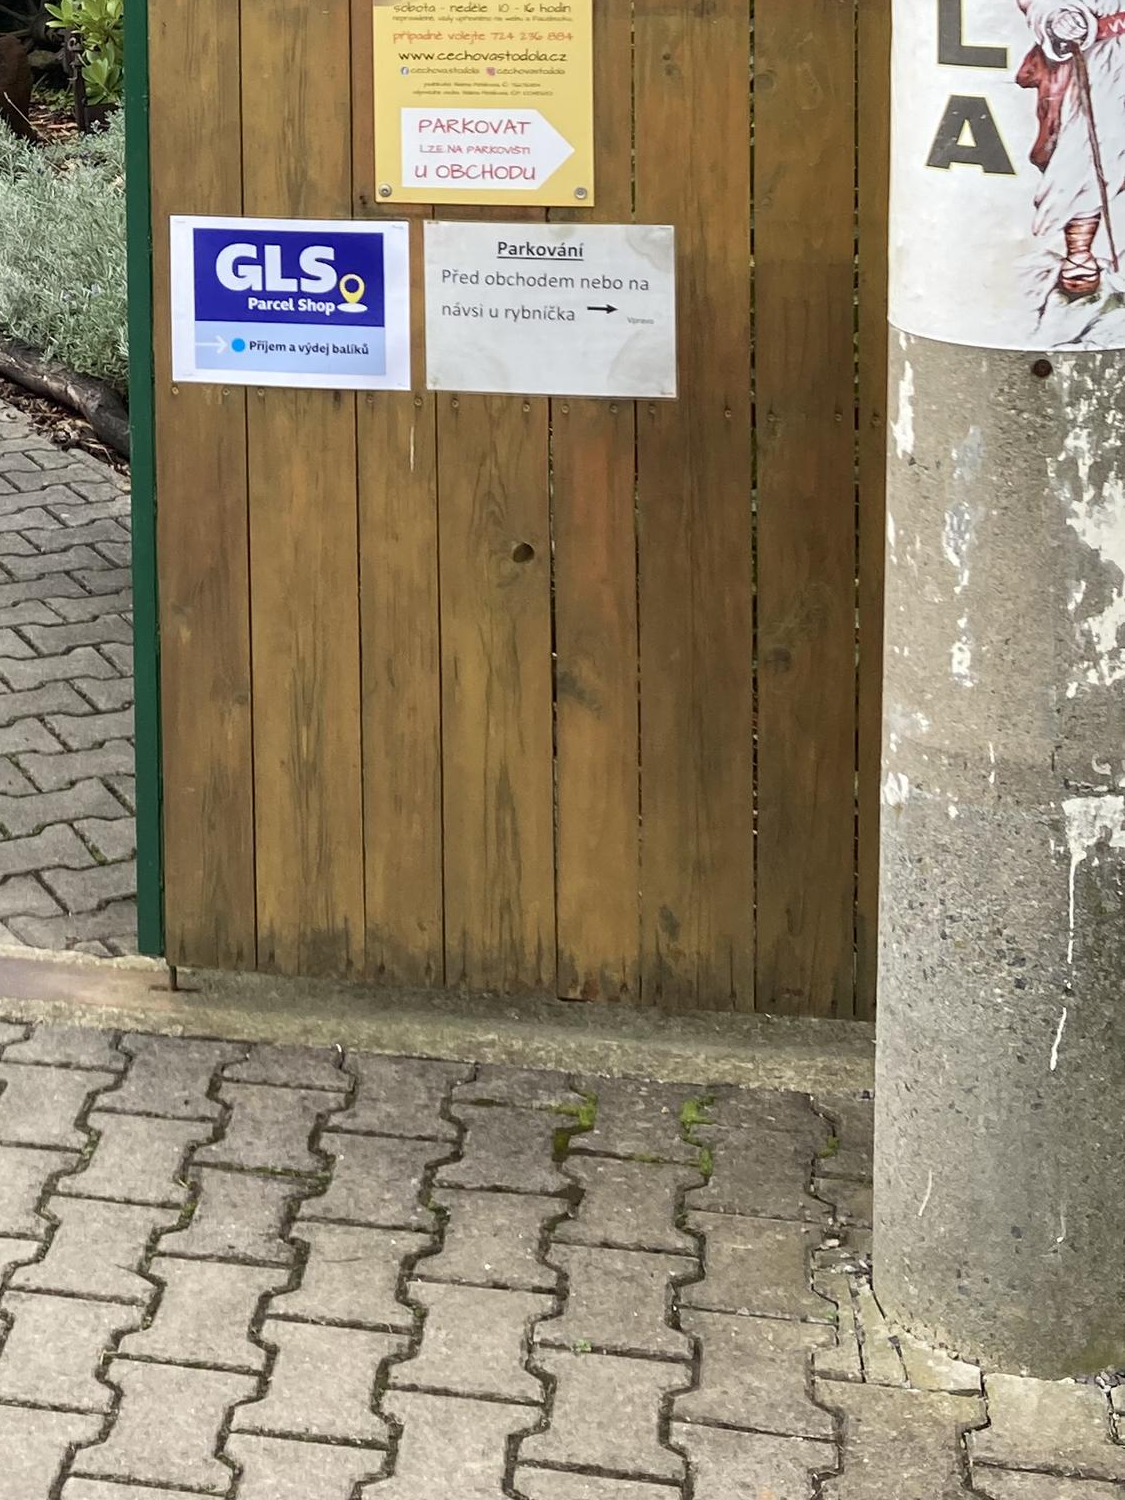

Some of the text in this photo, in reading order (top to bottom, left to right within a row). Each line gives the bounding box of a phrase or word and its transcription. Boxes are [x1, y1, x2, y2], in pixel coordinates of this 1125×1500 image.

[394, 3, 436, 13] sobota
[450, 2, 488, 13] neděle
[498, 4, 510, 13] 10
[523, 4, 535, 13] 16
[539, 3, 571, 13] hodin
[393, 30, 443, 44] případně
[448, 30, 486, 45] volejte
[491, 32, 514, 41] 724
[398, 48, 567, 62] www.cechovastodola.cz
[418, 118, 531, 135] PARKOVAT
[419, 144, 444, 154] LZE
[448, 144, 463, 154] NA
[435, 164, 536, 181] OBCHODU
[497, 240, 584, 258] Parkování
[215, 243, 338, 293] GLS
[442, 269, 650, 291] Před obchodem nebo na
[248, 297, 335, 316] Parcel Shop
[441, 303, 576, 323] návsi u rybníčka
[249, 340, 370, 357] Příjem a výdej balíků
